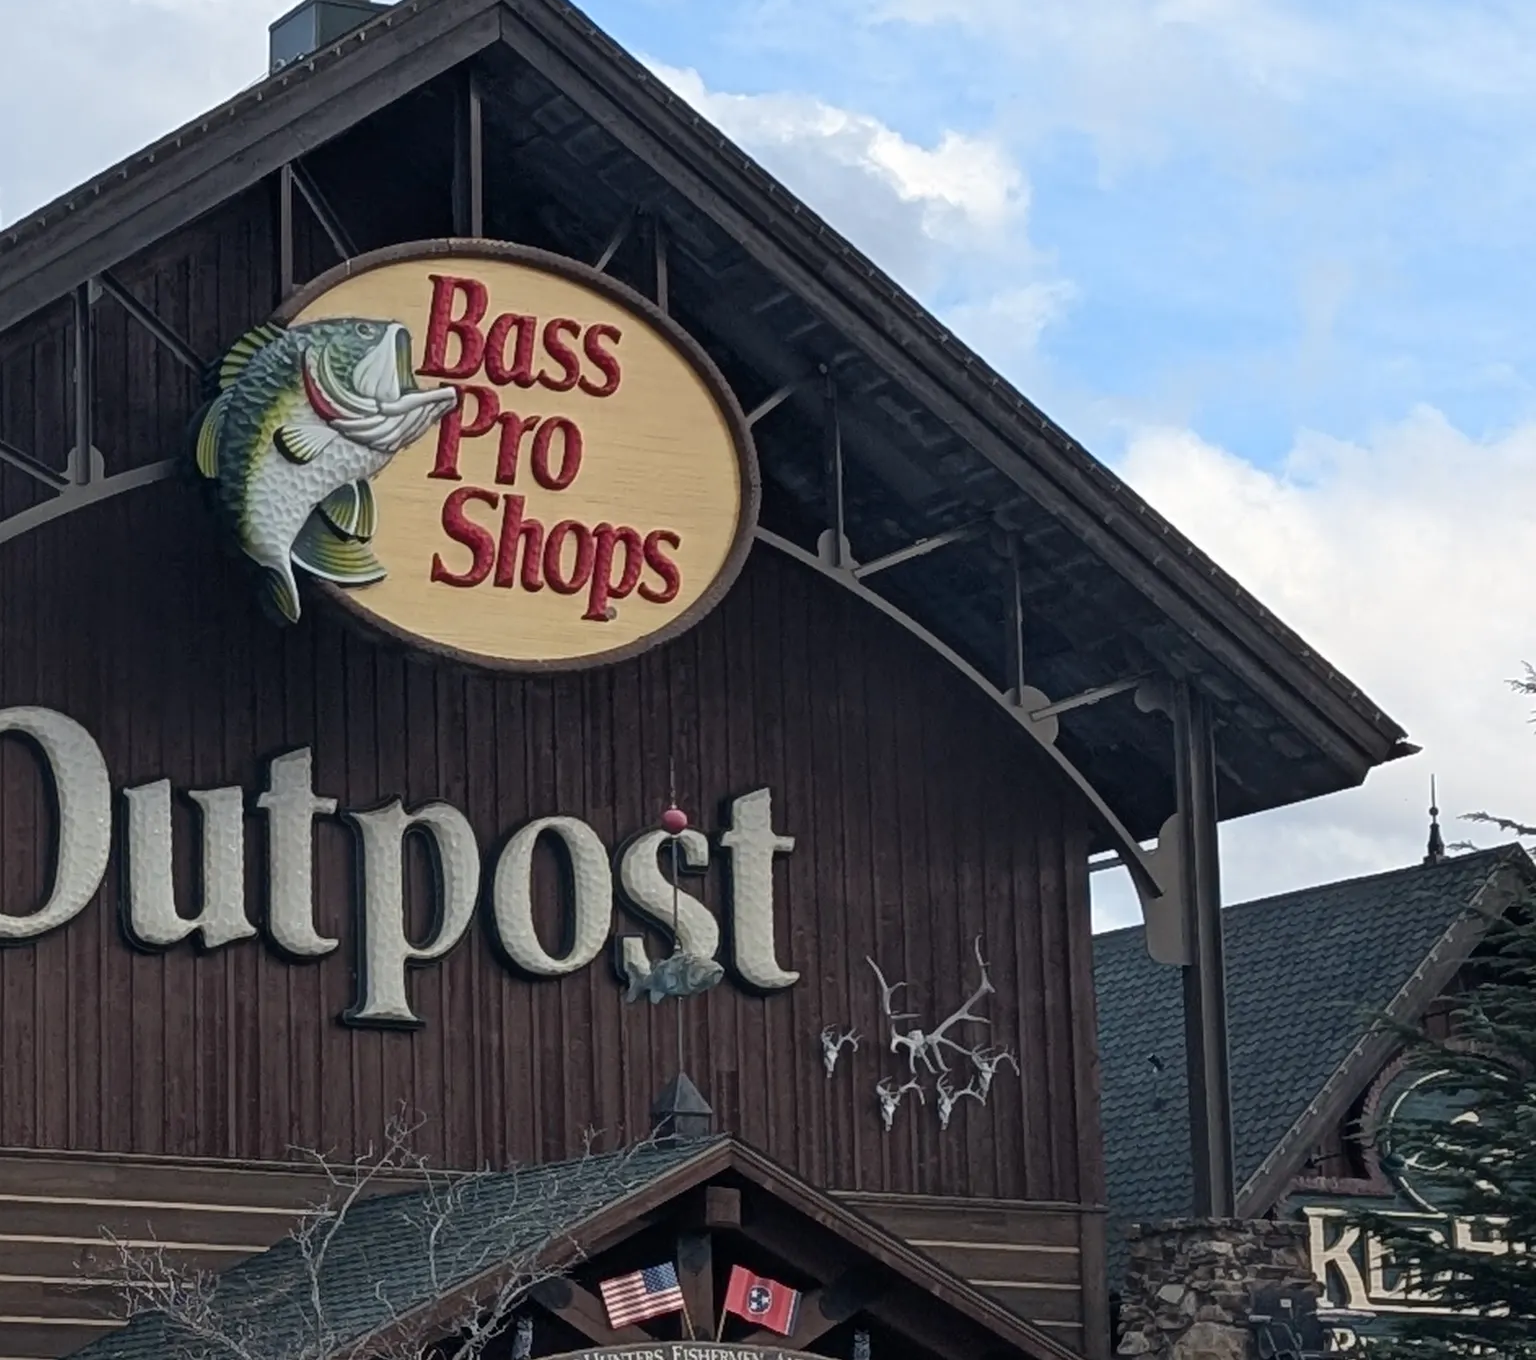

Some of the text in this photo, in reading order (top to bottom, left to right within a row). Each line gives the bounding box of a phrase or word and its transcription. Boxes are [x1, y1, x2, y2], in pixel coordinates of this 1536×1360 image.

[415, 274, 622, 397] Bass
[428, 382, 583, 491] Pro
[430, 486, 681, 622] Shops
